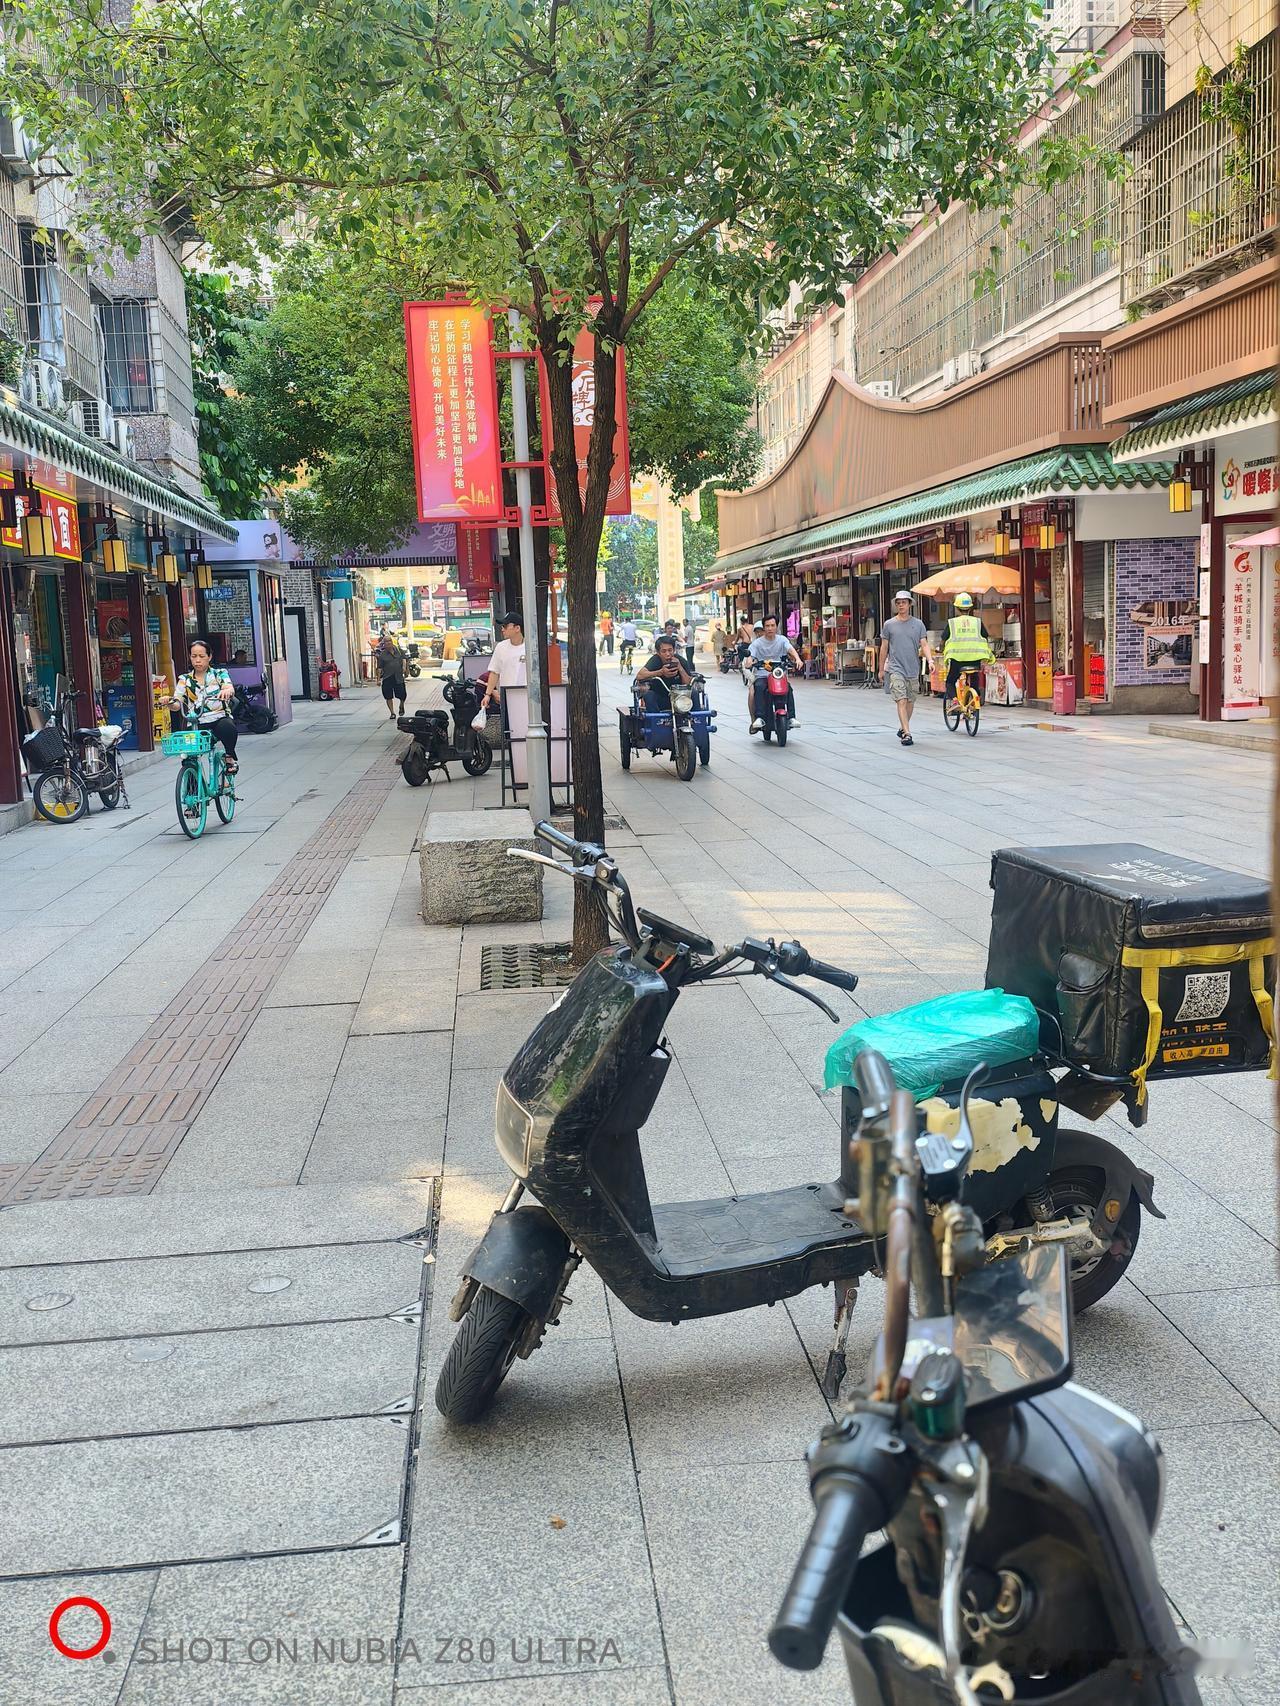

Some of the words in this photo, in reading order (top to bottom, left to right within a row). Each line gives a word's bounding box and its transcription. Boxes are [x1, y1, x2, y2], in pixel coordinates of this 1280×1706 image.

[428, 319, 442, 388] 牢记初心使命
[460, 319, 477, 444] 学习和践行伟大建党精神
[433, 392, 447, 460] 开创美好未来
[444, 319, 465, 489] 在新的征程上更加坚定更加自觉地
[1150, 615, 1190, 627] 2016年
